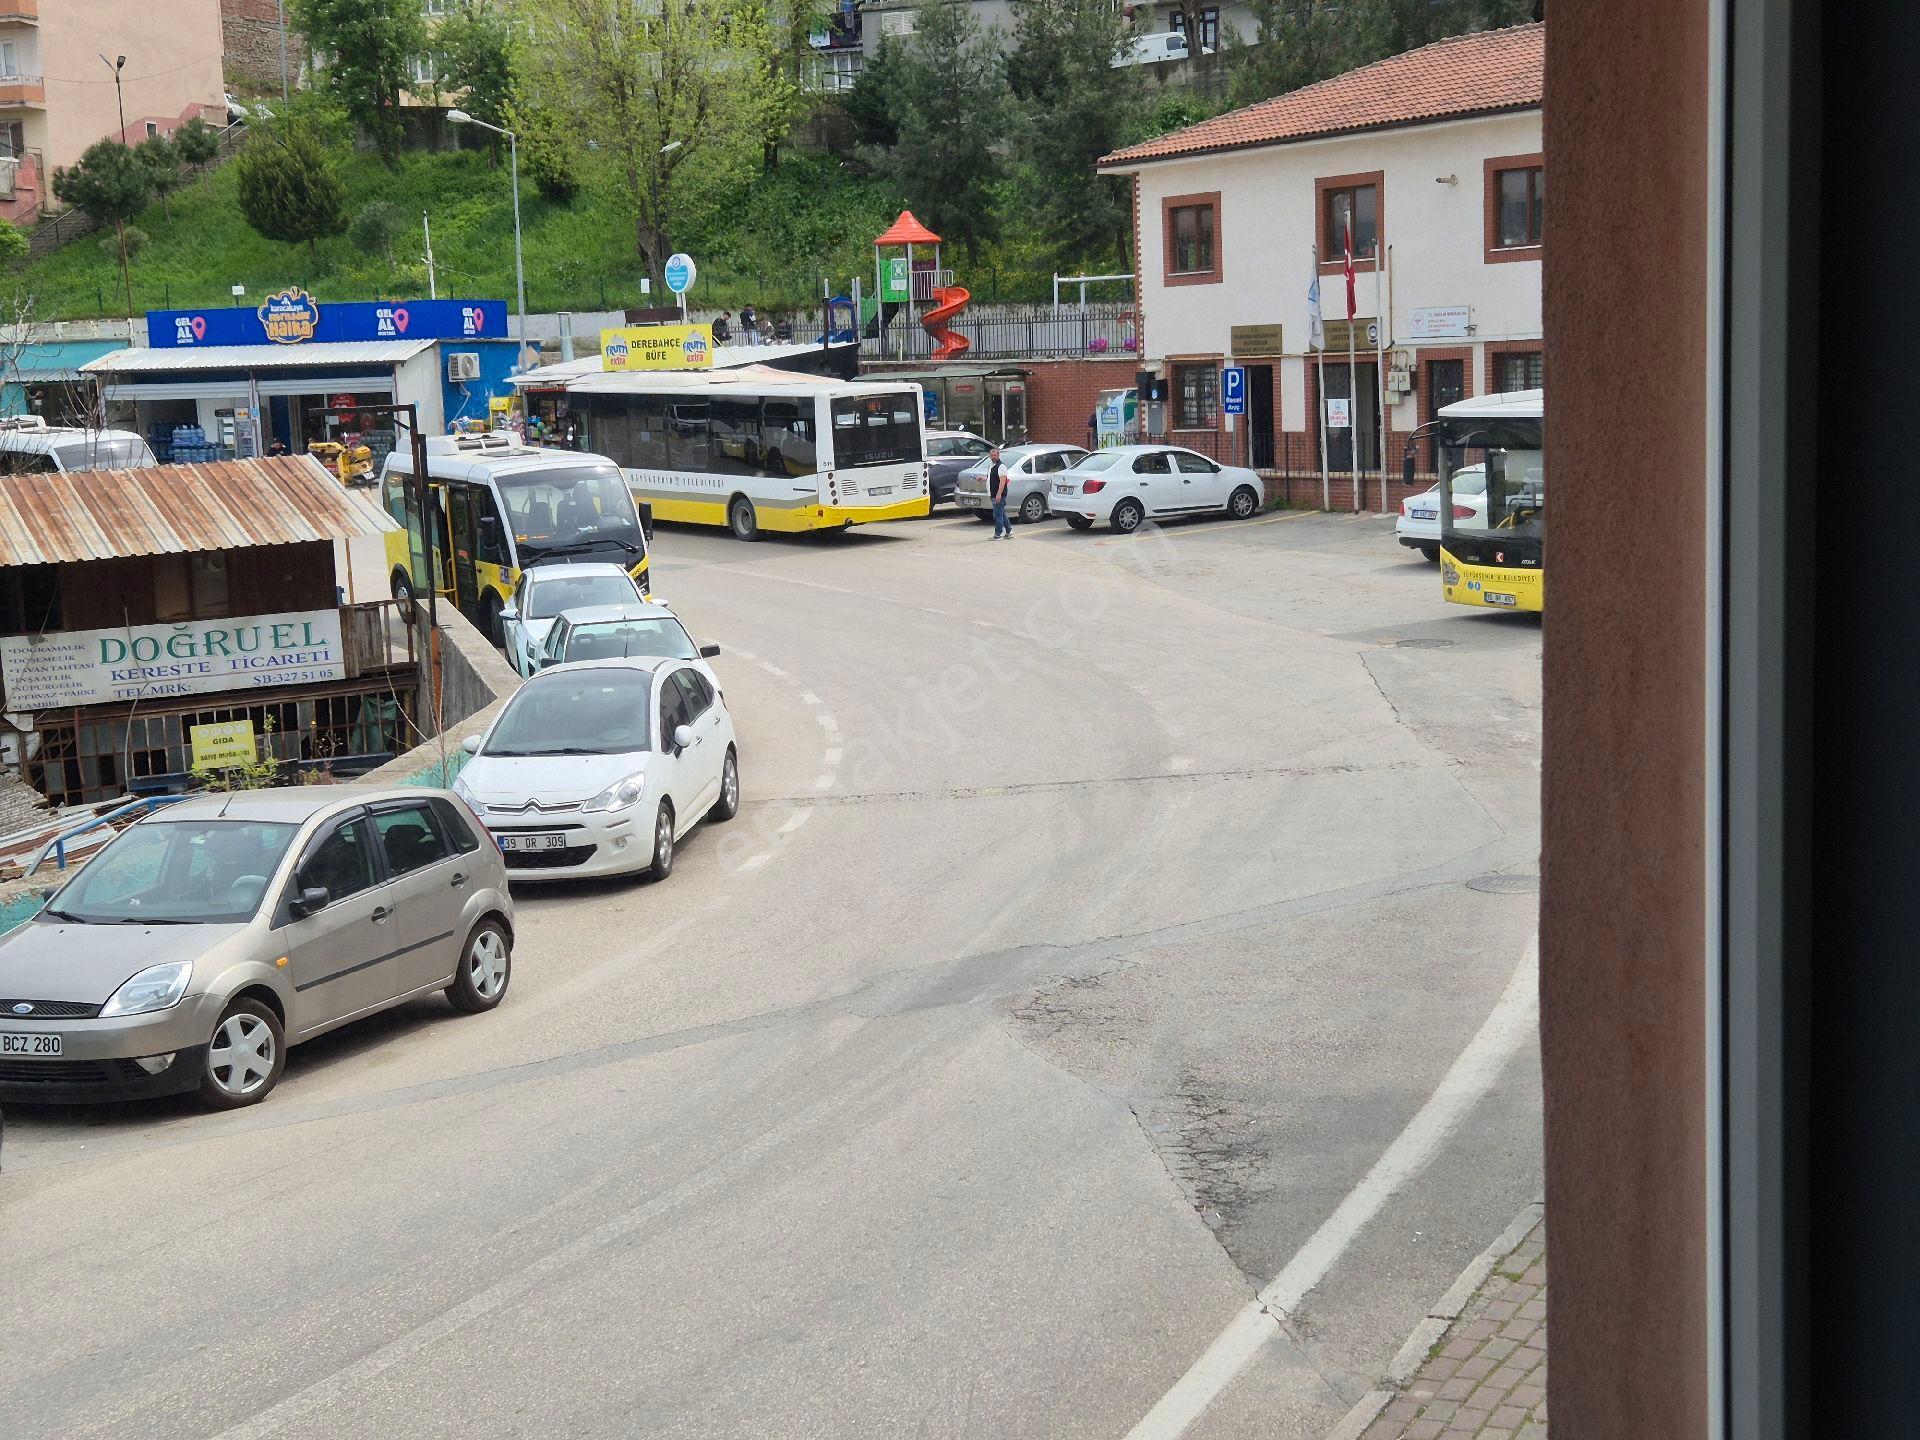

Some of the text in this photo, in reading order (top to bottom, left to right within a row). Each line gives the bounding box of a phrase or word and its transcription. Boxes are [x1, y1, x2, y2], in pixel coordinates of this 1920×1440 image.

[378, 318, 395, 331] AL
[177, 326, 193, 339] AL
[631, 338, 681, 349] DEREBAHÇE
[645, 350, 667, 361] BÜFE
[1227, 371, 1240, 396] P
[864, 451, 894, 460] ISUZU
[99, 621, 329, 665] DOĞRUEL
[110, 648, 331, 682] KERESTE TİCARETİ
[301, 671, 315, 680] 51
[319, 669, 334, 678] 05
[212, 736, 234, 746] GIDA
[504, 837, 517, 849] 39
[545, 836, 564, 848] 309
[3, 1035, 61, 1053] BCZ 280
